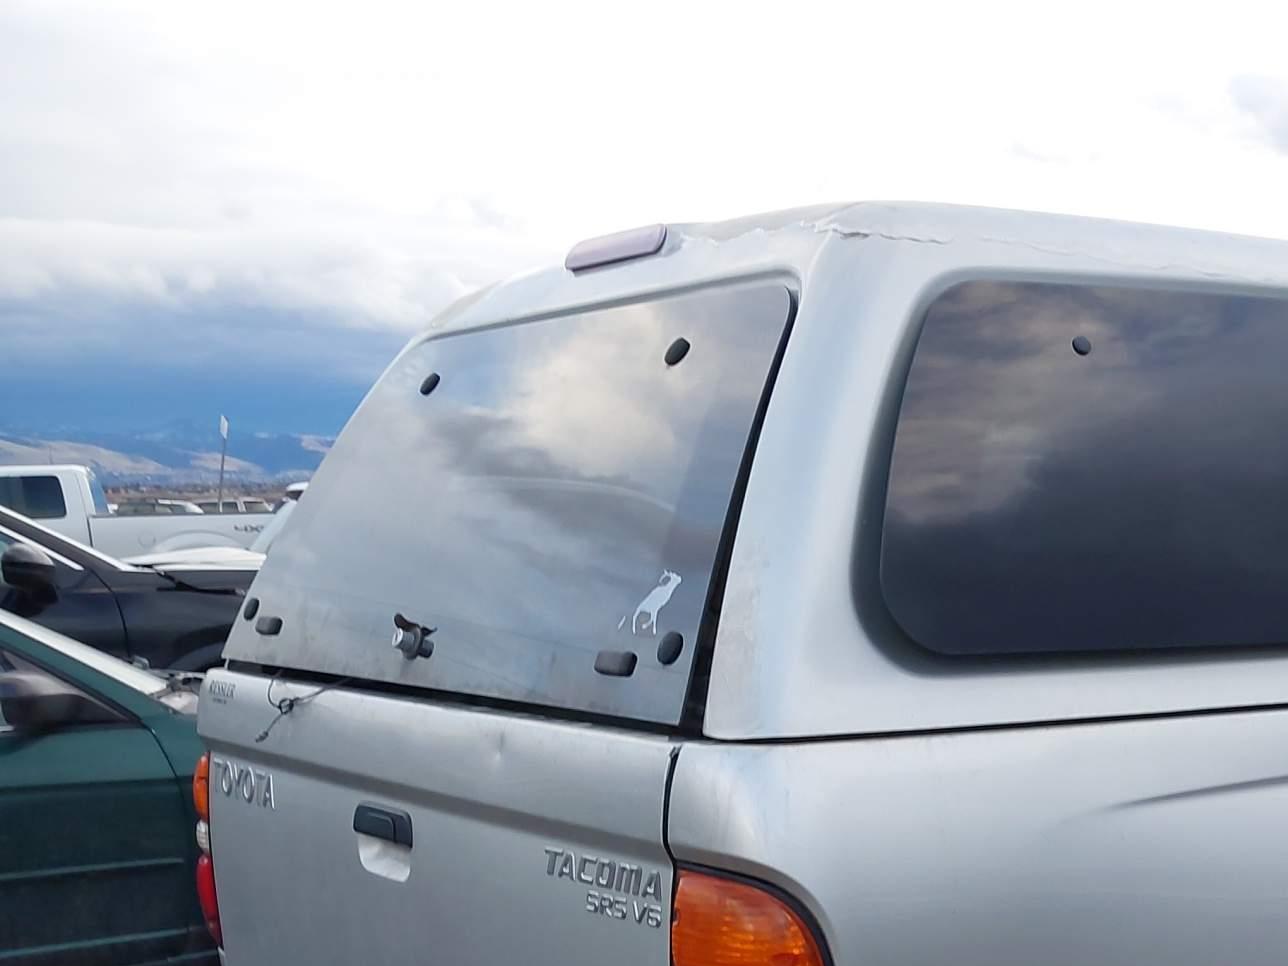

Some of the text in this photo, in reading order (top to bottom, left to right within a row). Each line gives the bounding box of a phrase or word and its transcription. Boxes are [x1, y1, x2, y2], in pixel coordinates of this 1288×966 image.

[213, 757, 276, 810] TOYOTA
[544, 846, 661, 901] TACOMA
[586, 890, 661, 928] SR5 V6
